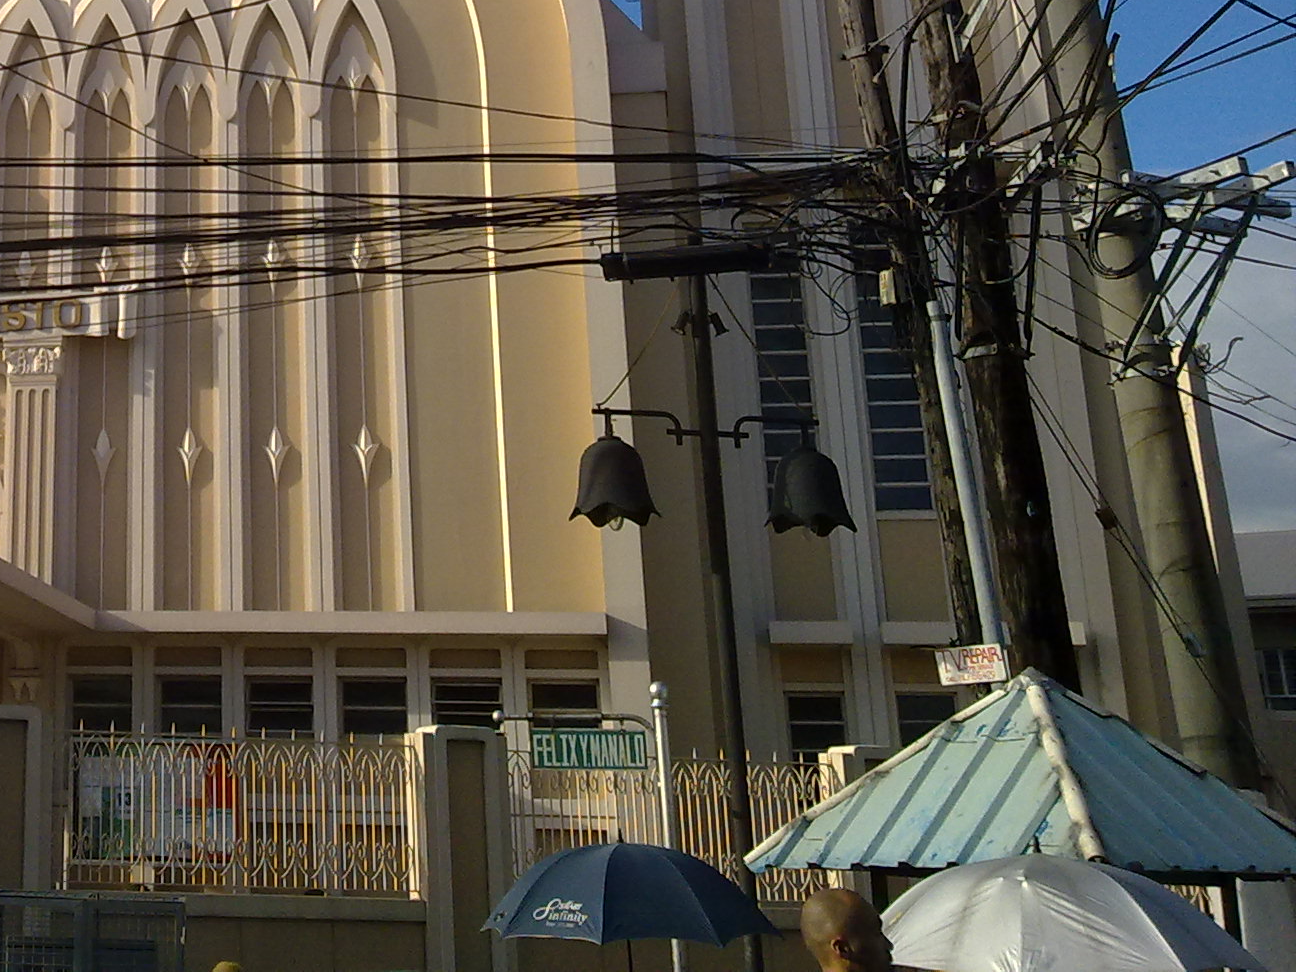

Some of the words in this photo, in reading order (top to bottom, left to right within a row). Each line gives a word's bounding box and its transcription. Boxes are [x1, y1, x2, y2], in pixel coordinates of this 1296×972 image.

[935, 648, 961, 673] TV
[961, 646, 1003, 666] REPAIR
[532, 734, 578, 767] FELIX
[590, 734, 645, 767] MANALO
